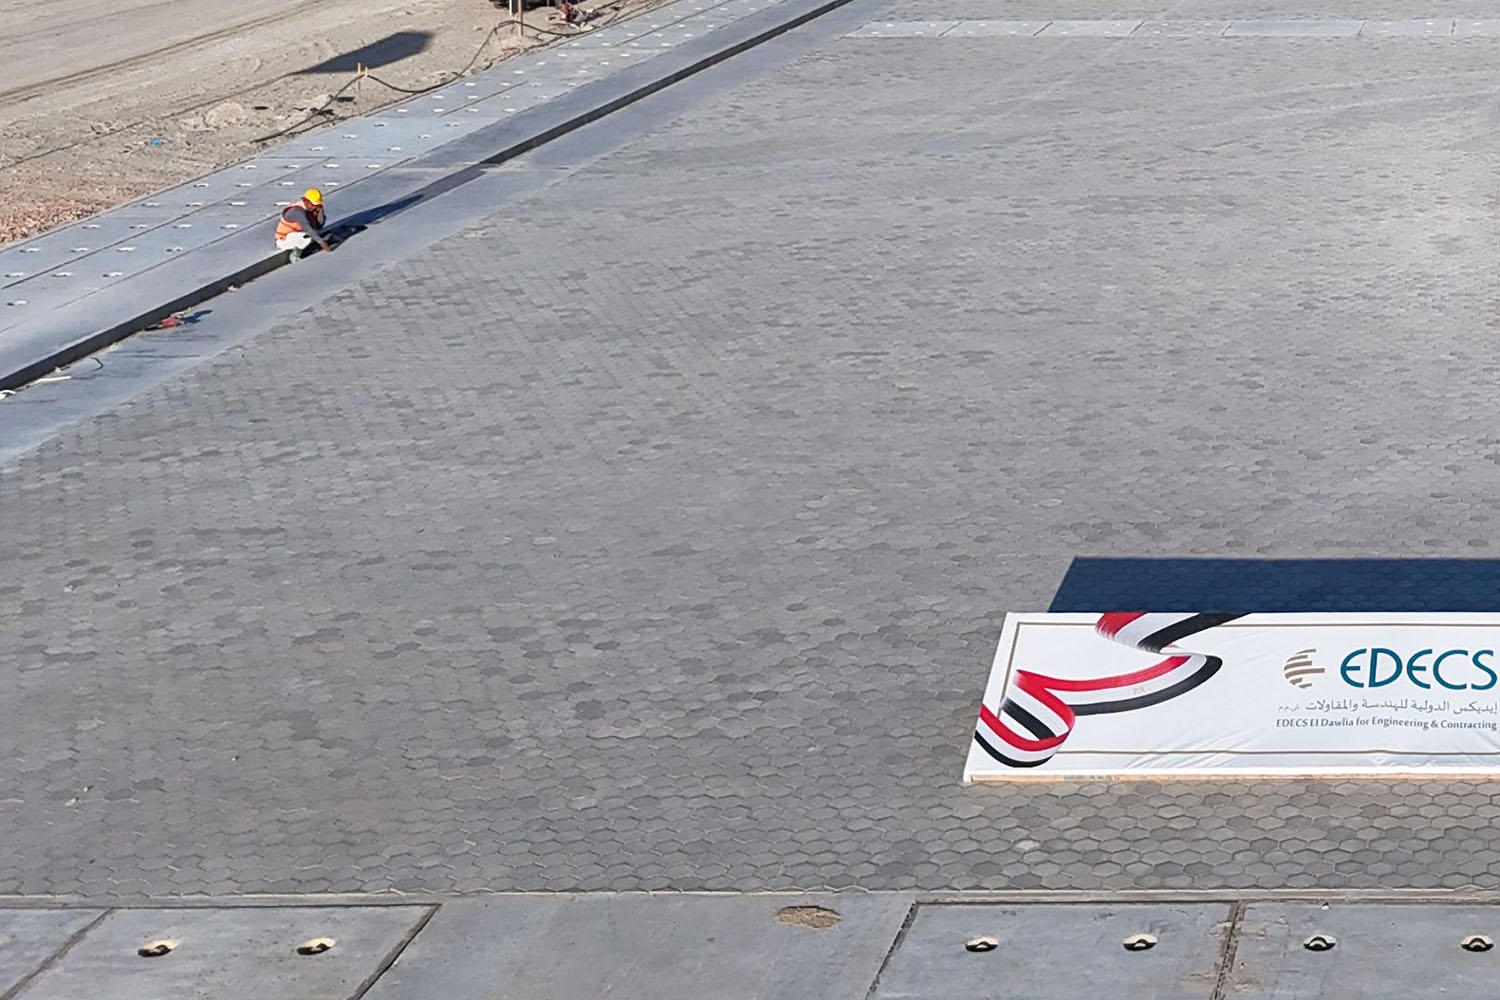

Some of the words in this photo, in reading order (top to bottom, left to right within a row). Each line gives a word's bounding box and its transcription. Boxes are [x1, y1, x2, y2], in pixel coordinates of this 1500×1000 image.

[1340, 647, 1498, 691] EDECS
[1305, 698, 1359, 712] والمقاولات
[1361, 698, 1408, 711] للهندسة
[1410, 699, 1450, 713] الدولية
[1453, 700, 1498, 715] إيديكس
[1276, 718, 1308, 727] EDECS
[1321, 716, 1354, 727] Dawlia
[1356, 716, 1370, 727] for
[1371, 716, 1429, 731] Engineering
[1431, 719, 1438, 728] &
[1440, 717, 1498, 731] Contracting
